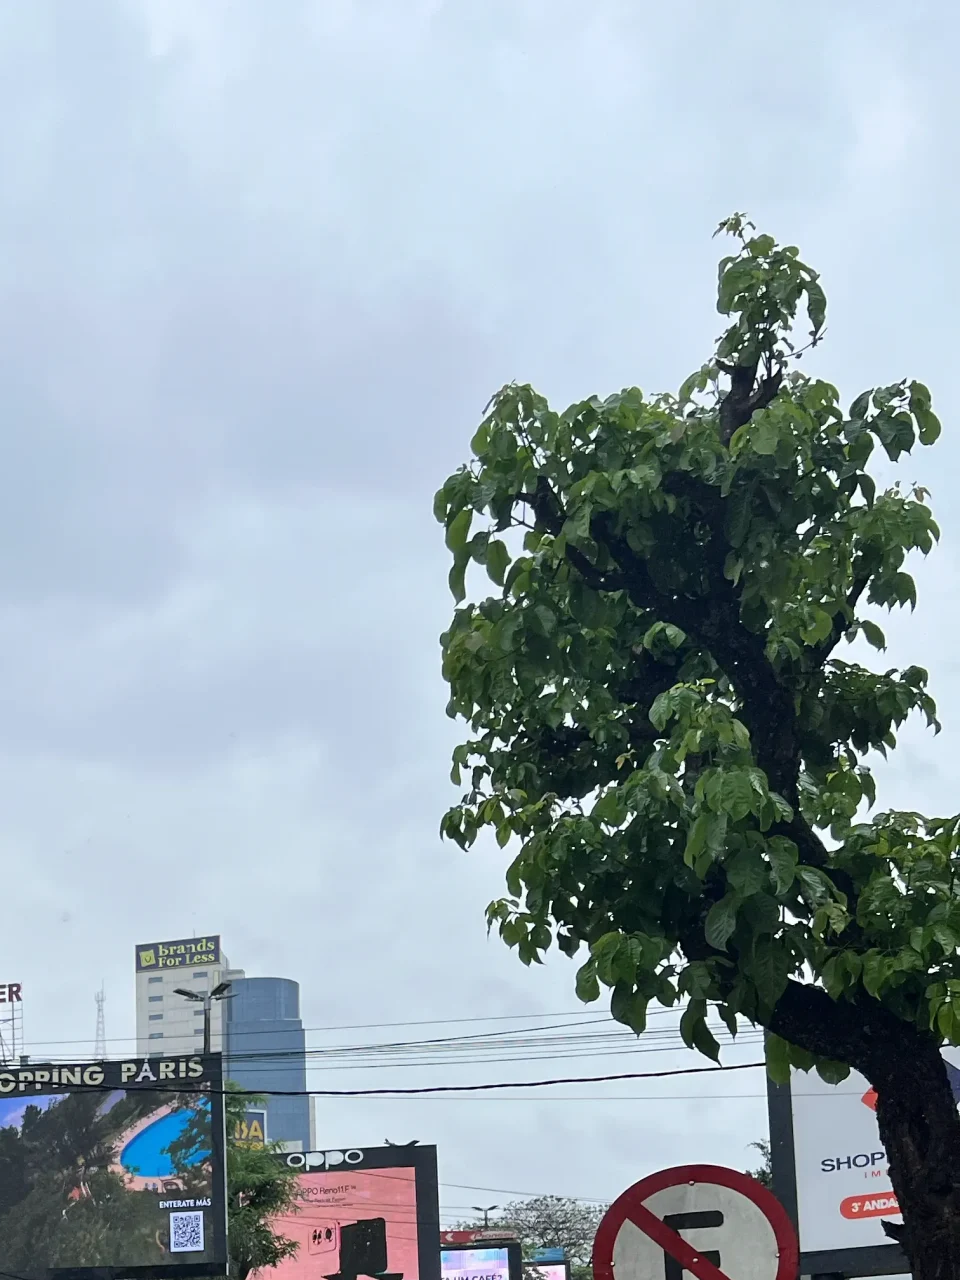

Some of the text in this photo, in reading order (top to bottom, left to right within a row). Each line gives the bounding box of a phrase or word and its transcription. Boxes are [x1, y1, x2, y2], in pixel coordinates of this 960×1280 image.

[157, 939, 215, 957] brands
[158, 953, 215, 967] For Less
[121, 1056, 204, 1083] PARIS
[820, 1152, 885, 1172] SHOP
[159, 1197, 212, 1209] ENTERATE MÁS
